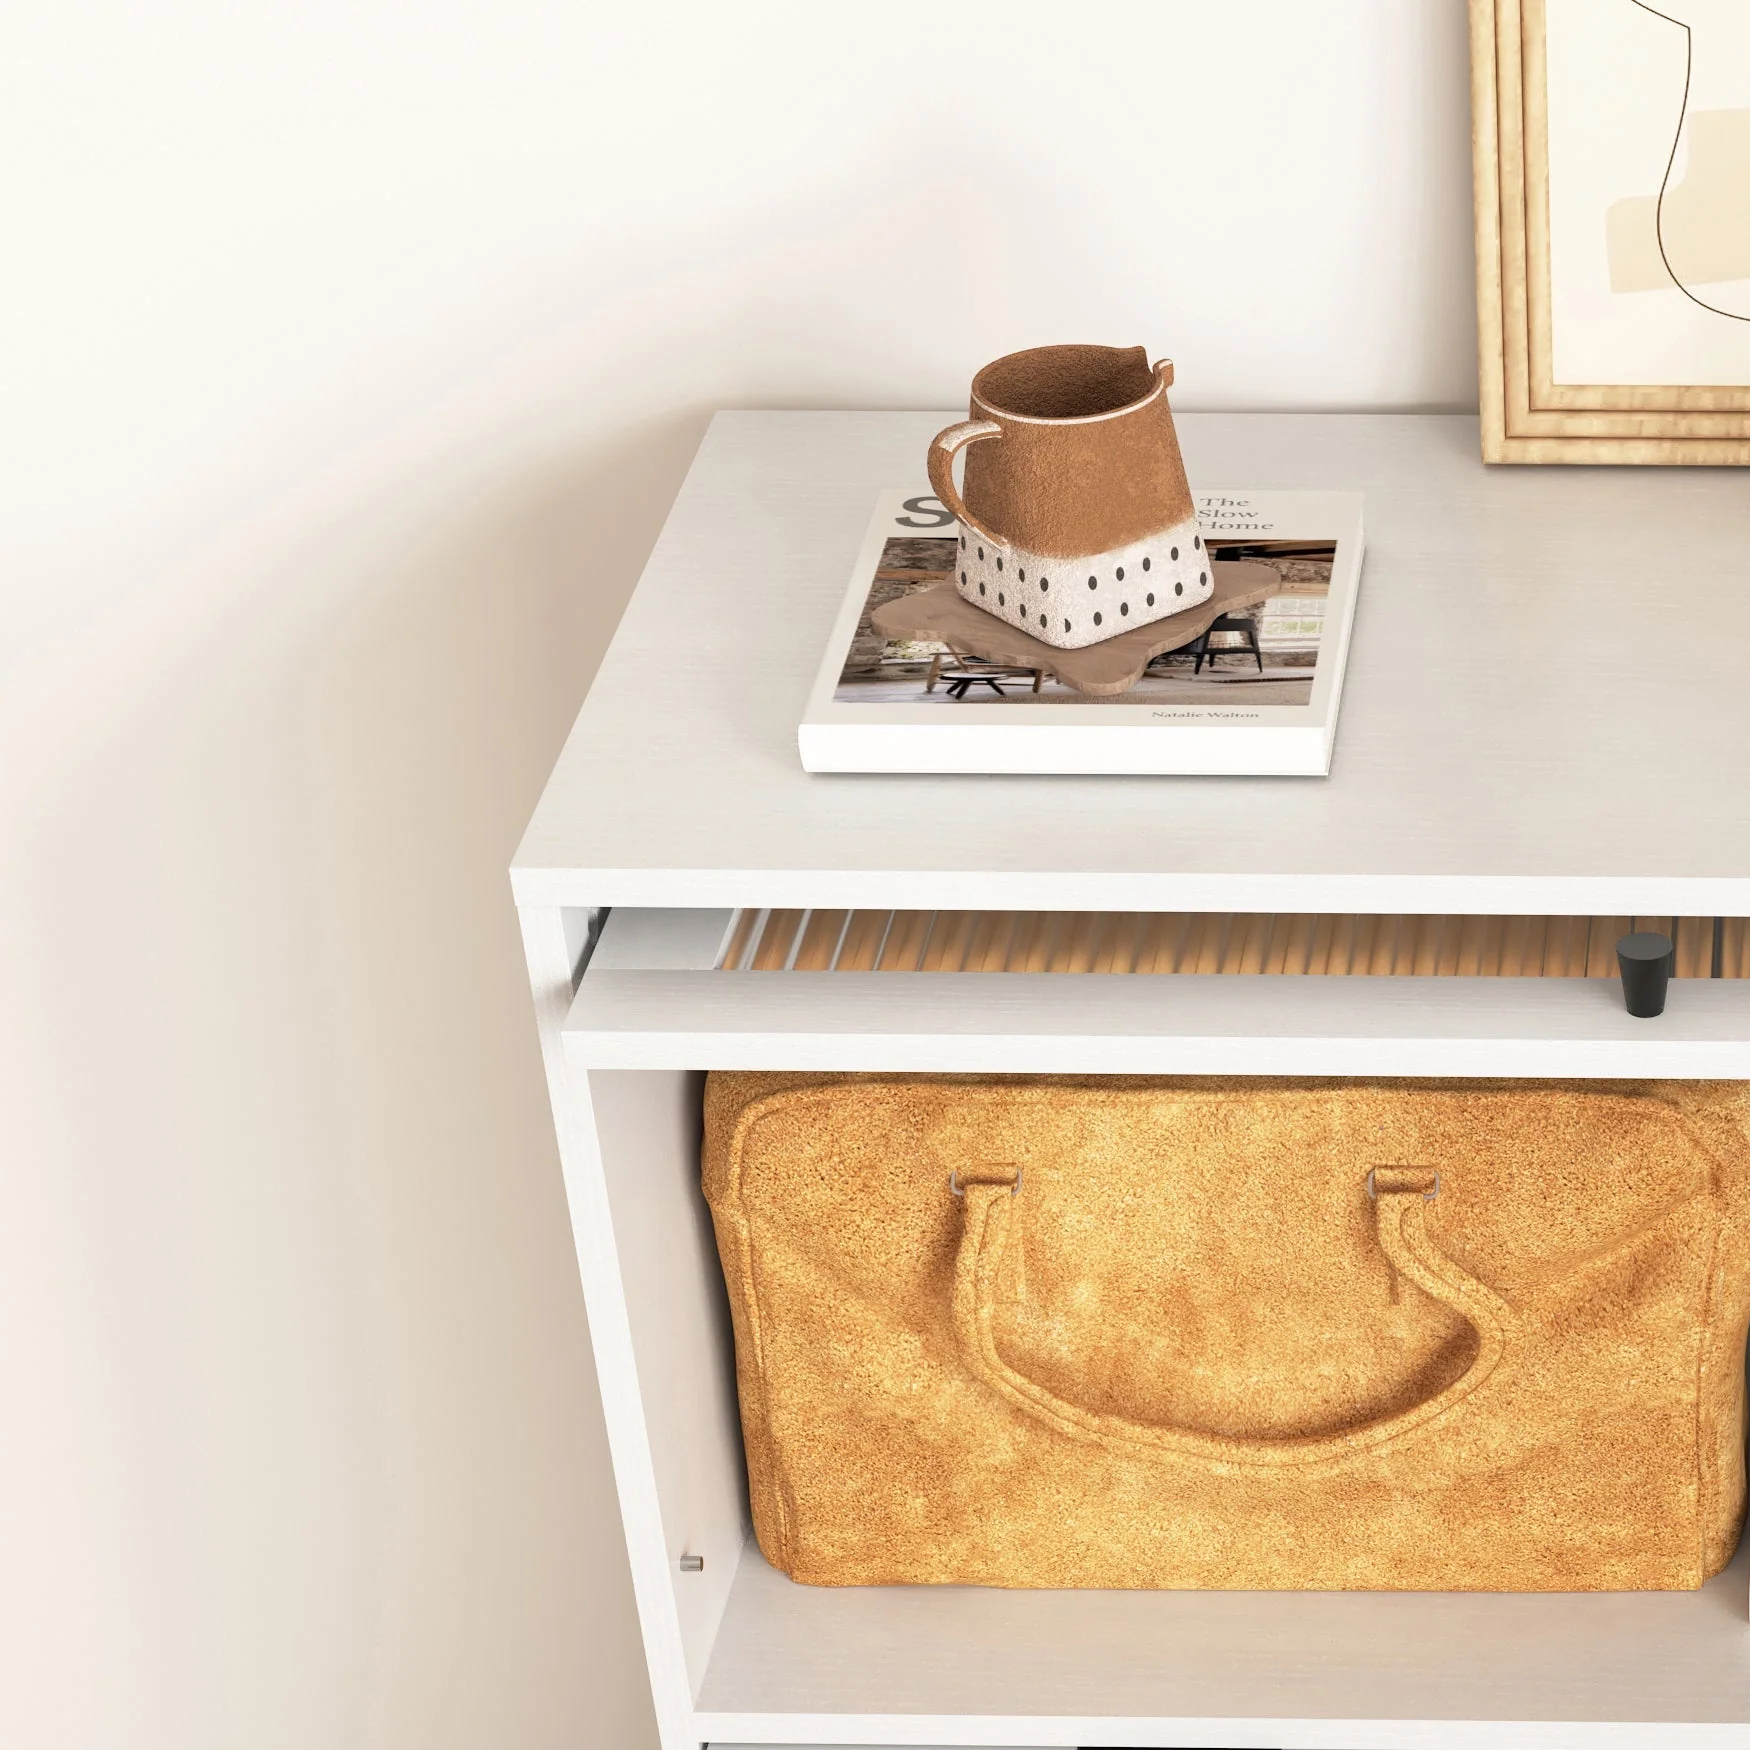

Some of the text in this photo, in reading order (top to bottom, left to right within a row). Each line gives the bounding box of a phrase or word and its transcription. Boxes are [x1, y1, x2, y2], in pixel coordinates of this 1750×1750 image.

[1199, 498, 1250, 507] The
[1197, 509, 1259, 518] Slow
[1198, 521, 1275, 530] Home
